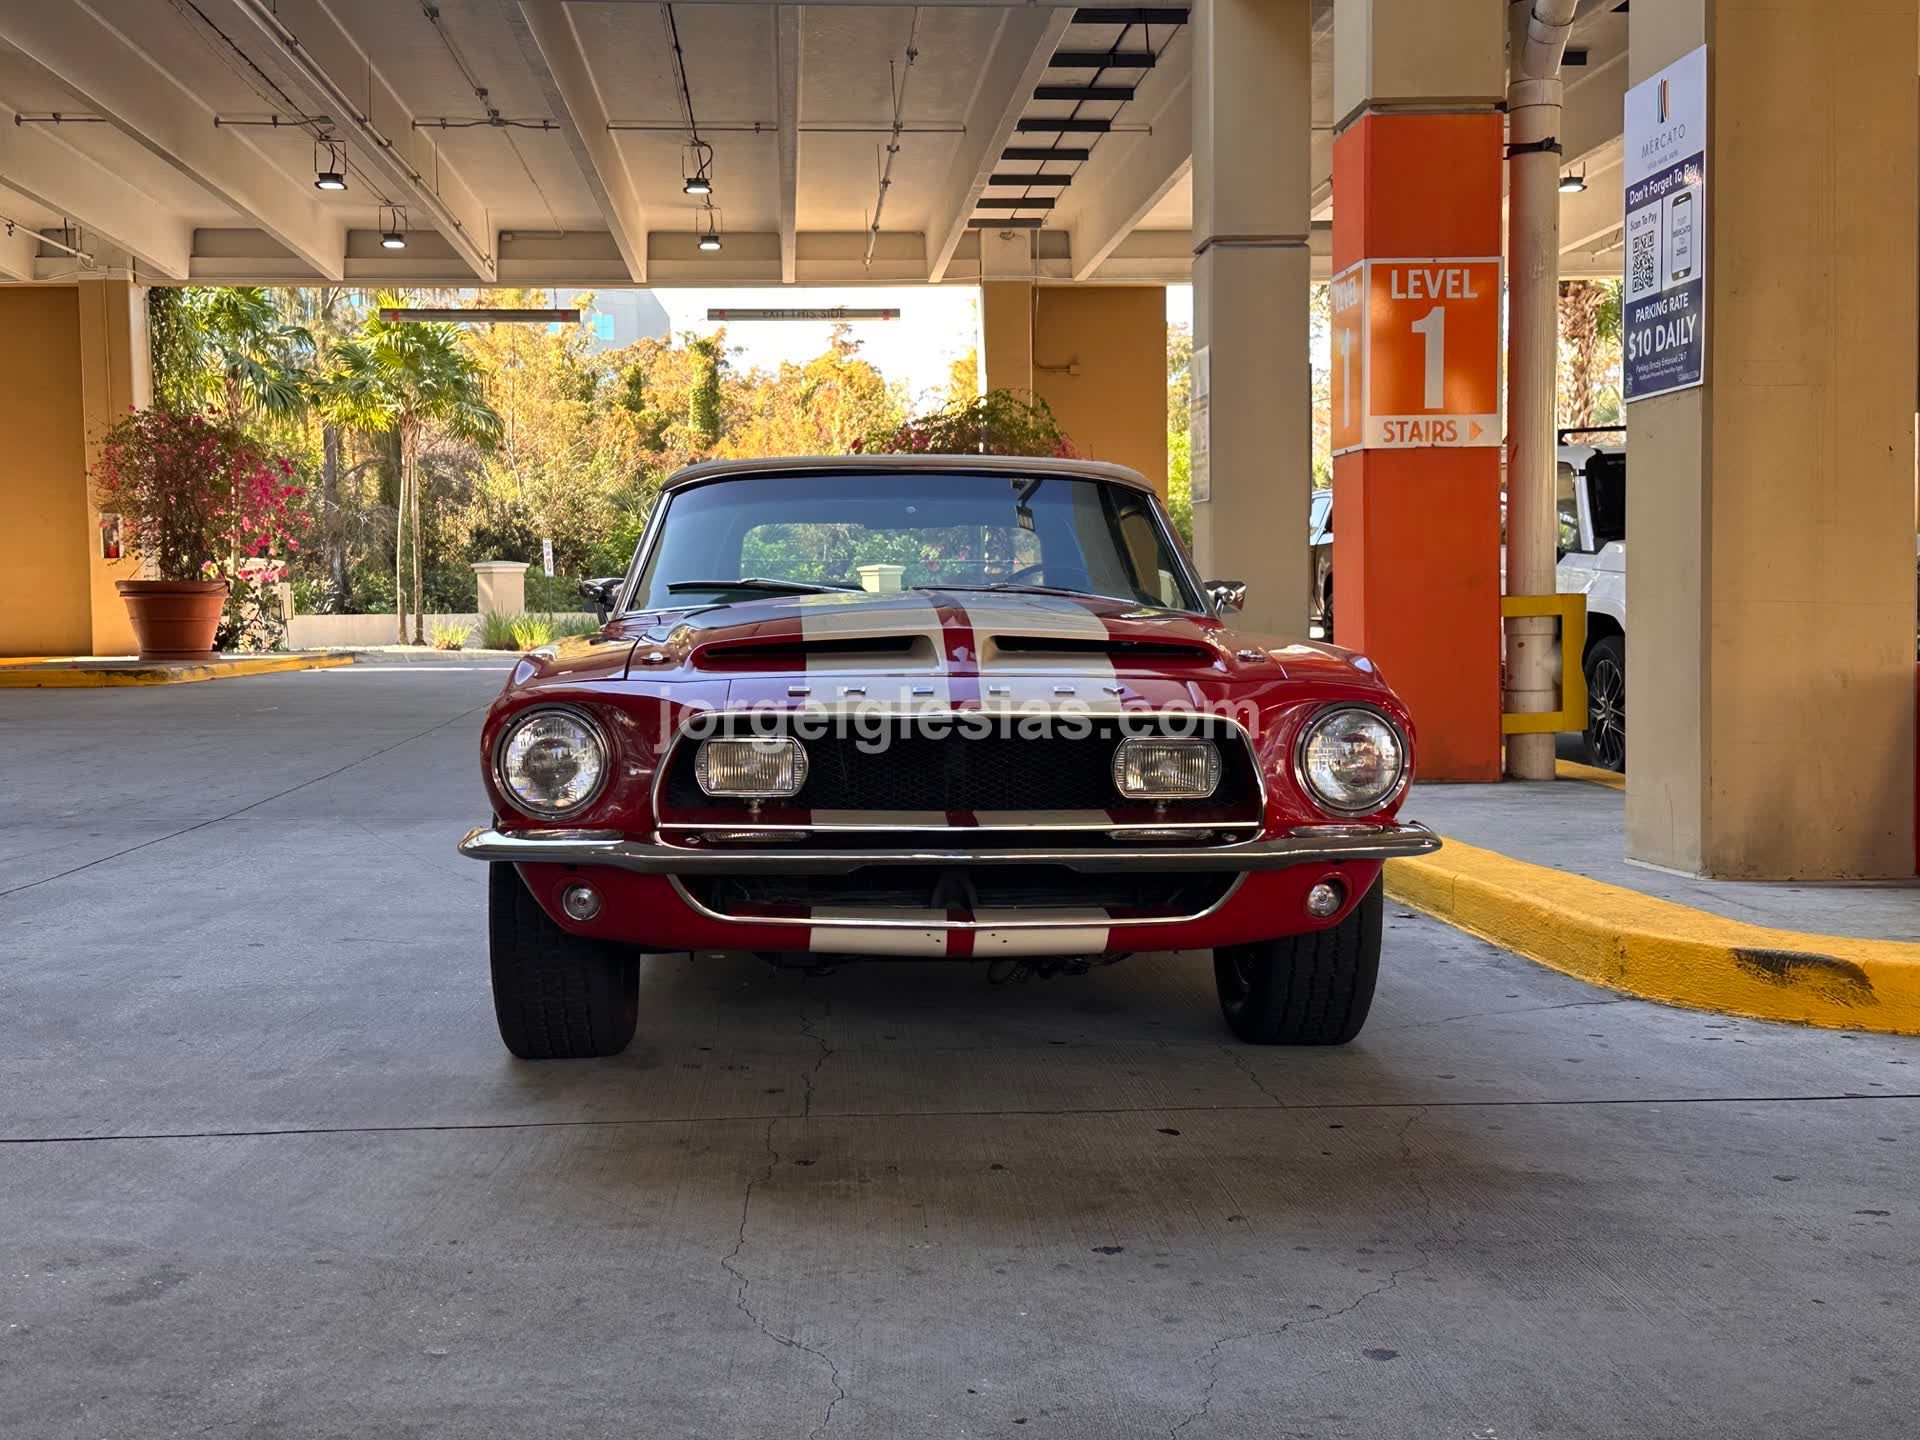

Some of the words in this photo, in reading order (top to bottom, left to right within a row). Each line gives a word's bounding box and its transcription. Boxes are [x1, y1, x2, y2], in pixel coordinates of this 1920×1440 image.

[1641, 124, 1686, 158] MERCATO
[1629, 185, 1648, 205] Don't
[1649, 175, 1673, 195] Forget
[1674, 168, 1683, 185] To
[1684, 163, 1698, 184] Pay
[1630, 219, 1641, 231] Scan
[1642, 215, 1648, 227] To
[1649, 213, 1657, 225] Pay
[1391, 268, 1478, 300] LEVEL
[762, 309, 784, 319] EXIT
[791, 309, 815, 319] THIS
[817, 309, 847, 319] SIDE
[1635, 298, 1668, 323] PARKING
[1669, 292, 1689, 312] RATE
[1628, 328, 1652, 362] $10
[1655, 313, 1697, 352] DAILY
[1411, 306, 1445, 410] 1
[1382, 420, 1458, 443] STAIRS
